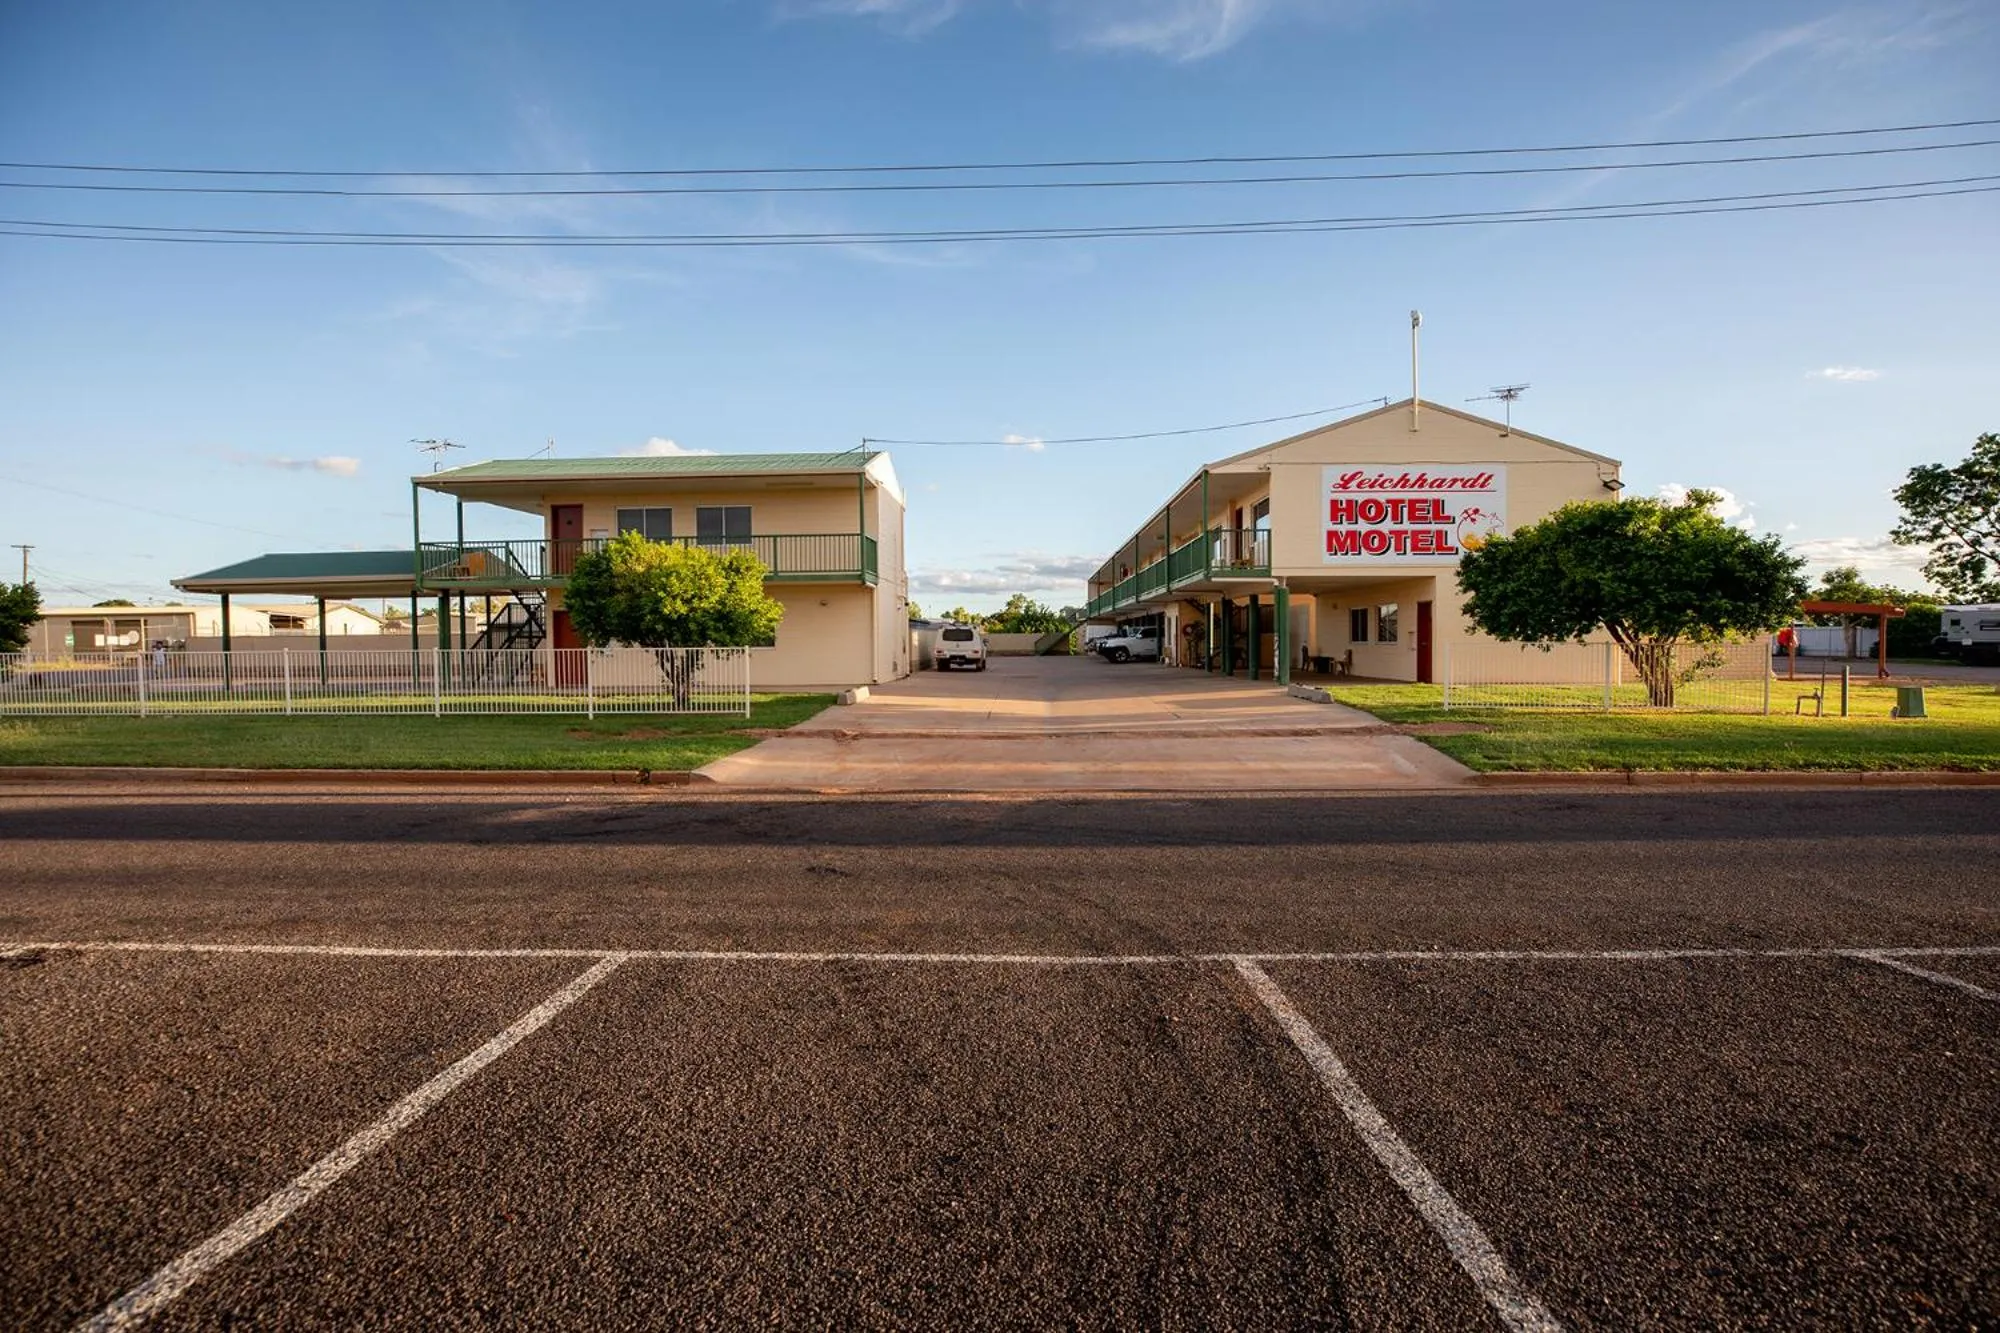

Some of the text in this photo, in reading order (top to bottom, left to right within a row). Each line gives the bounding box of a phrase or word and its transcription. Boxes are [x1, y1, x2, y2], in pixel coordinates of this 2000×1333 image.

[1332, 470, 1494, 490] Leichhardt
[1329, 498, 1455, 525] HOTEL
[1326, 529, 1458, 556] MOTEL
